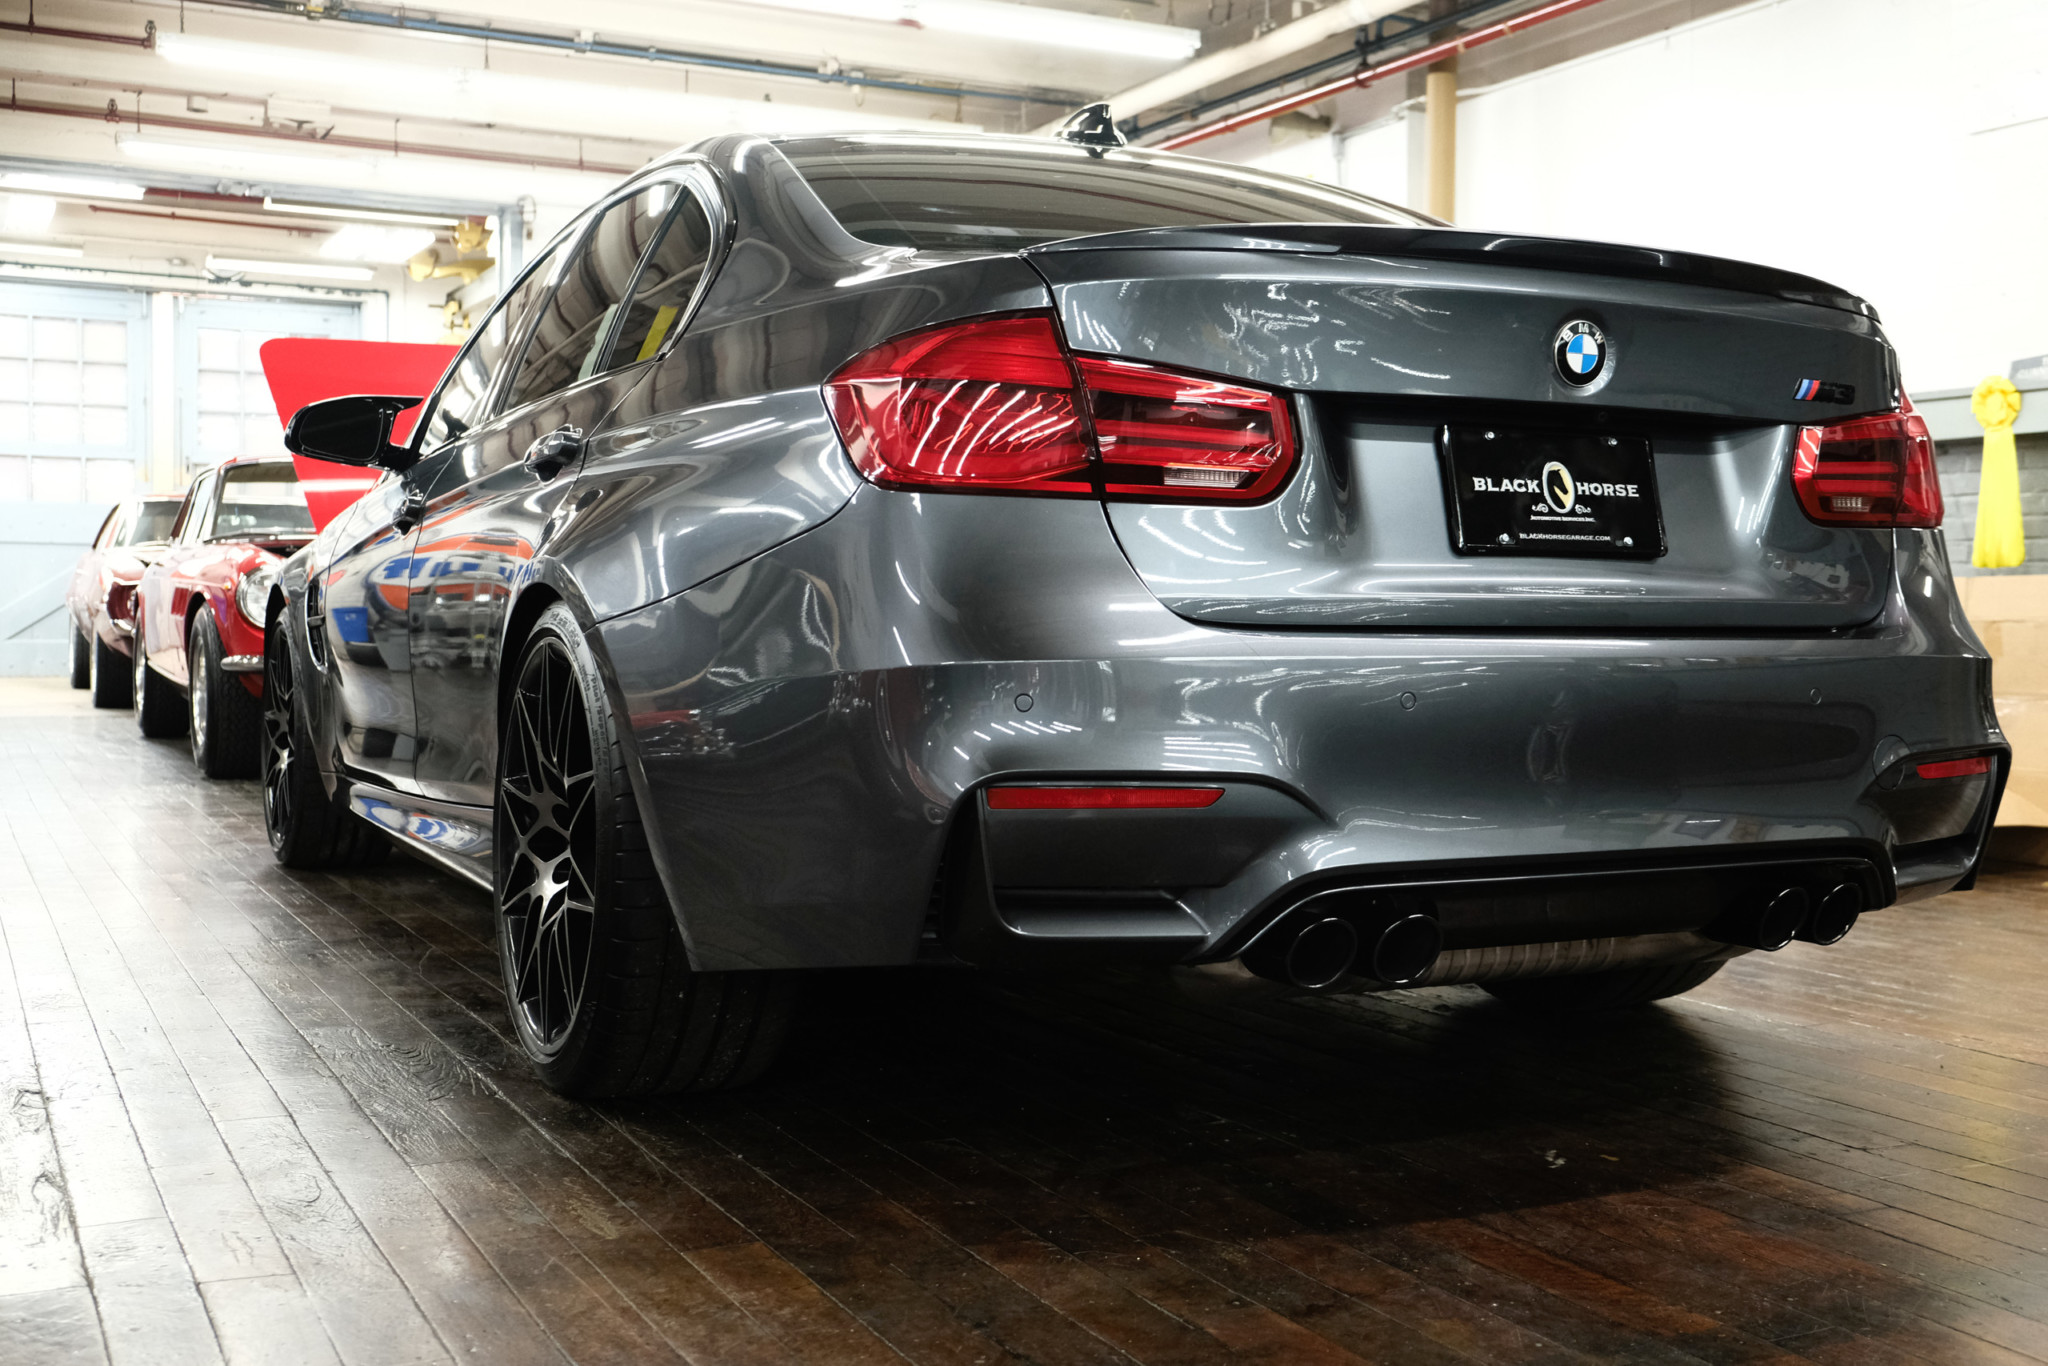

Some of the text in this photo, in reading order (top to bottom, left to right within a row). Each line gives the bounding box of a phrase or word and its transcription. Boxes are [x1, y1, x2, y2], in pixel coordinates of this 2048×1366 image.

[1562, 322, 1604, 345] BMW
[1472, 476, 1640, 498] BLACK HORSE
[1519, 532, 1611, 541] BLACKHORSEGARAGE.COM
